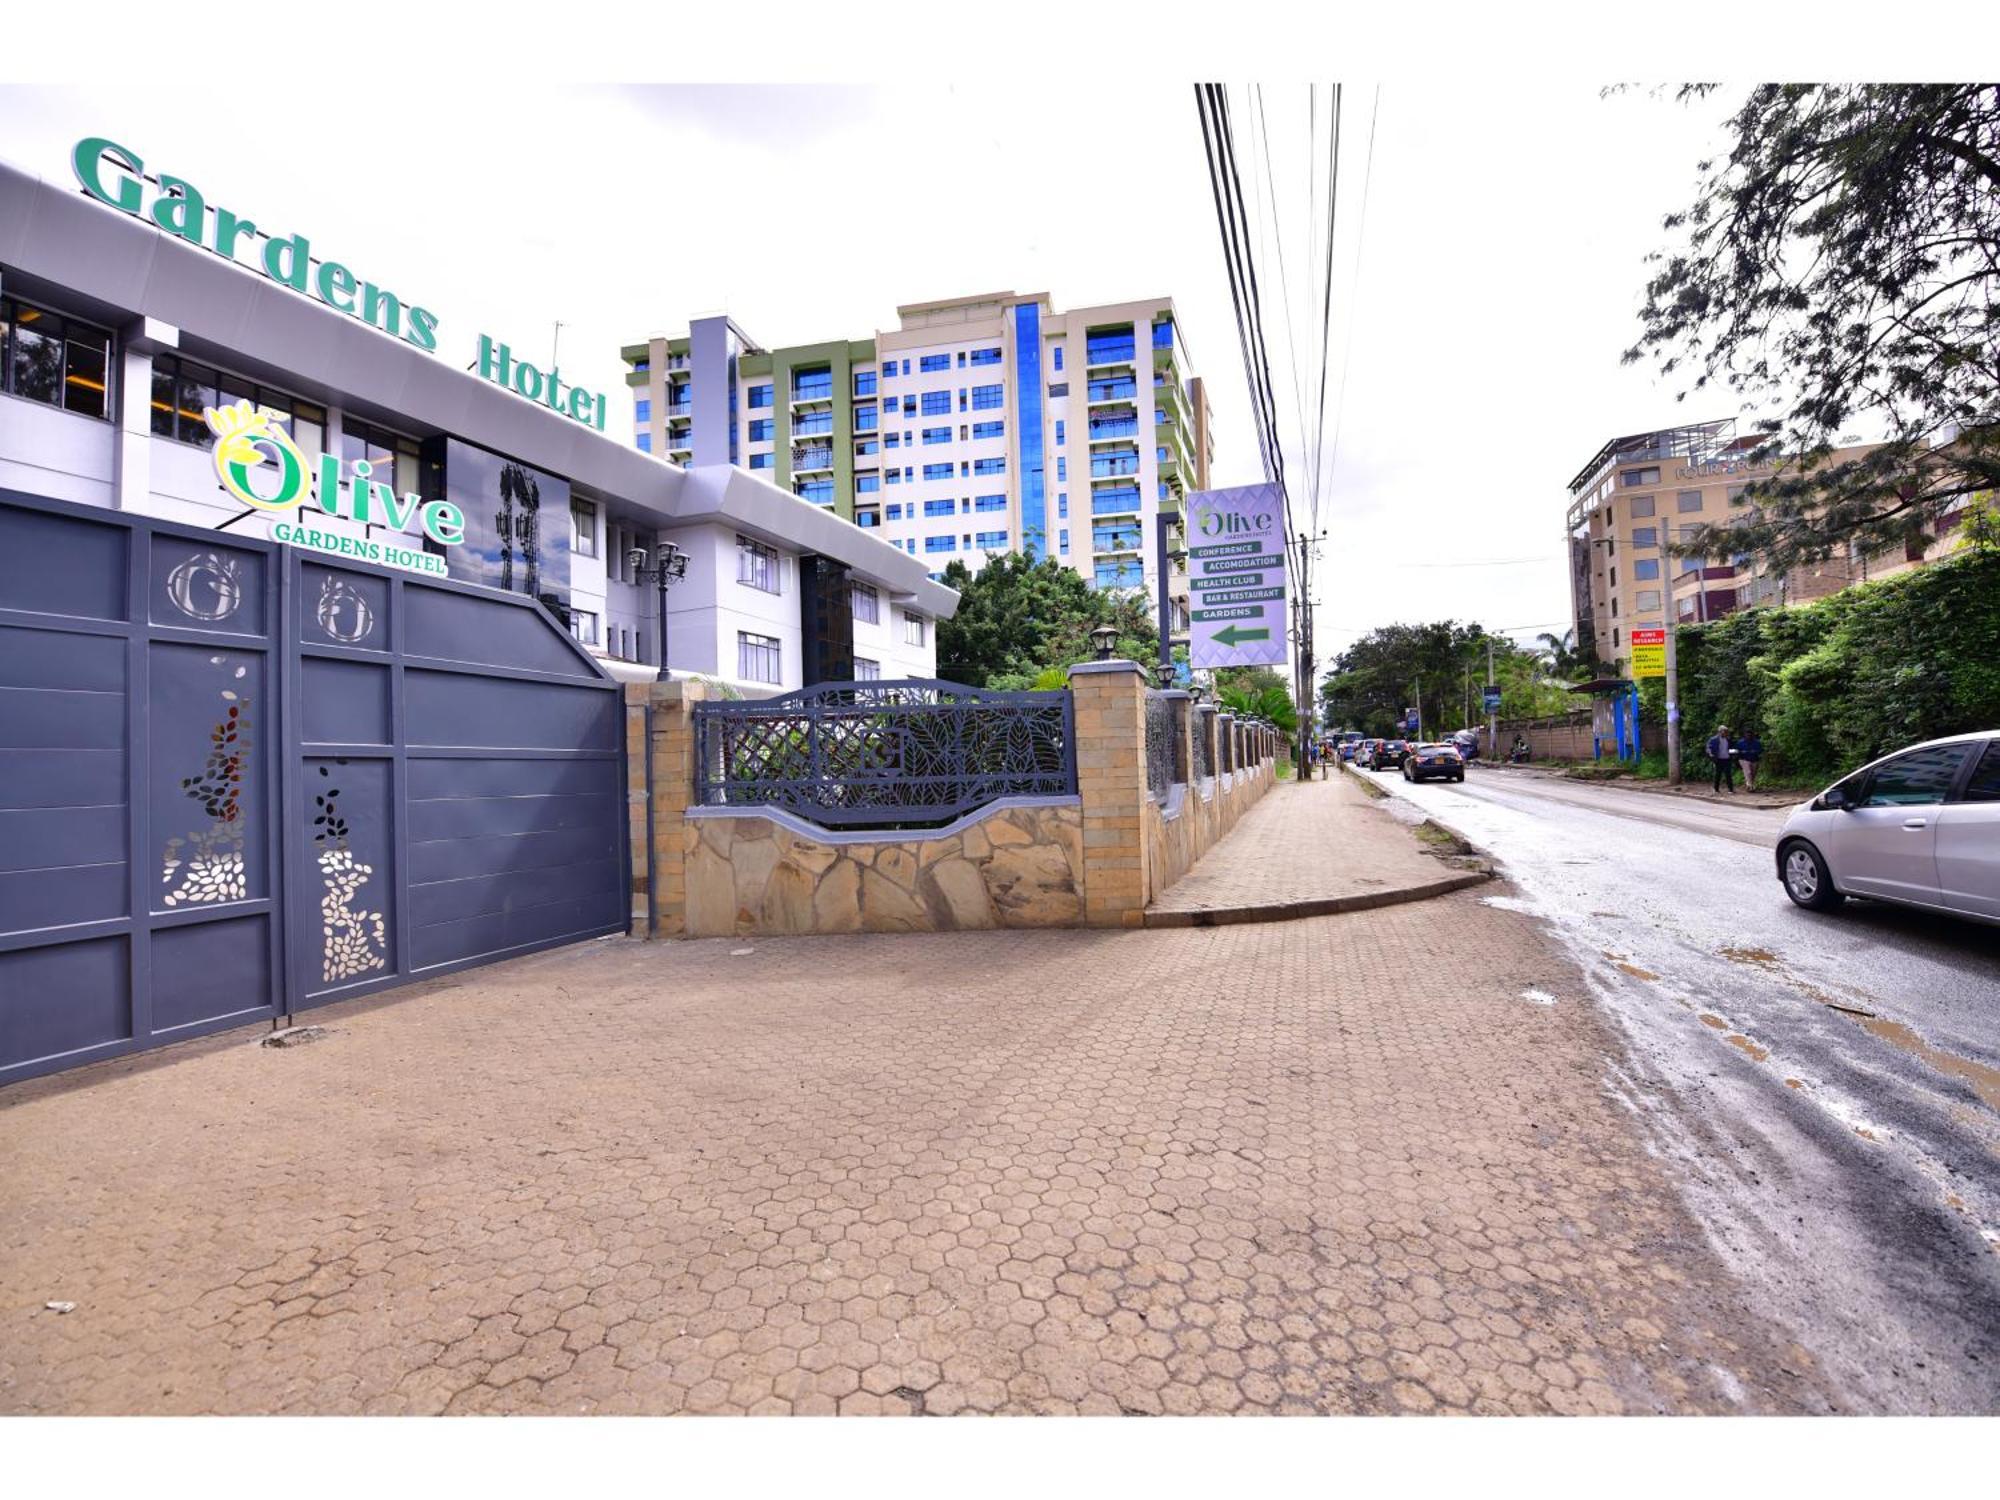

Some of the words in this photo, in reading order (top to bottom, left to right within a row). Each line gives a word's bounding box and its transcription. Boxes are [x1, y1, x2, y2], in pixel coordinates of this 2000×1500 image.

[71, 136, 440, 351] Gardens
[477, 333, 606, 432] Hotel
[214, 424, 465, 545] Olive
[1200, 512, 1272, 536] Olive
[275, 523, 380, 560] GARDENS
[385, 546, 446, 574] HOTEL
[1198, 544, 1253, 557] CONFERENCE
[1209, 557, 1277, 571] ACCOMODATION
[1197, 578, 1231, 588] HEALTH
[1233, 576, 1256, 585] CLUB
[1206, 594, 1221, 602] BAR
[1222, 593, 1229, 601] &
[1230, 589, 1279, 600] RESTAURANT
[1203, 608, 1252, 618] GARDENS
